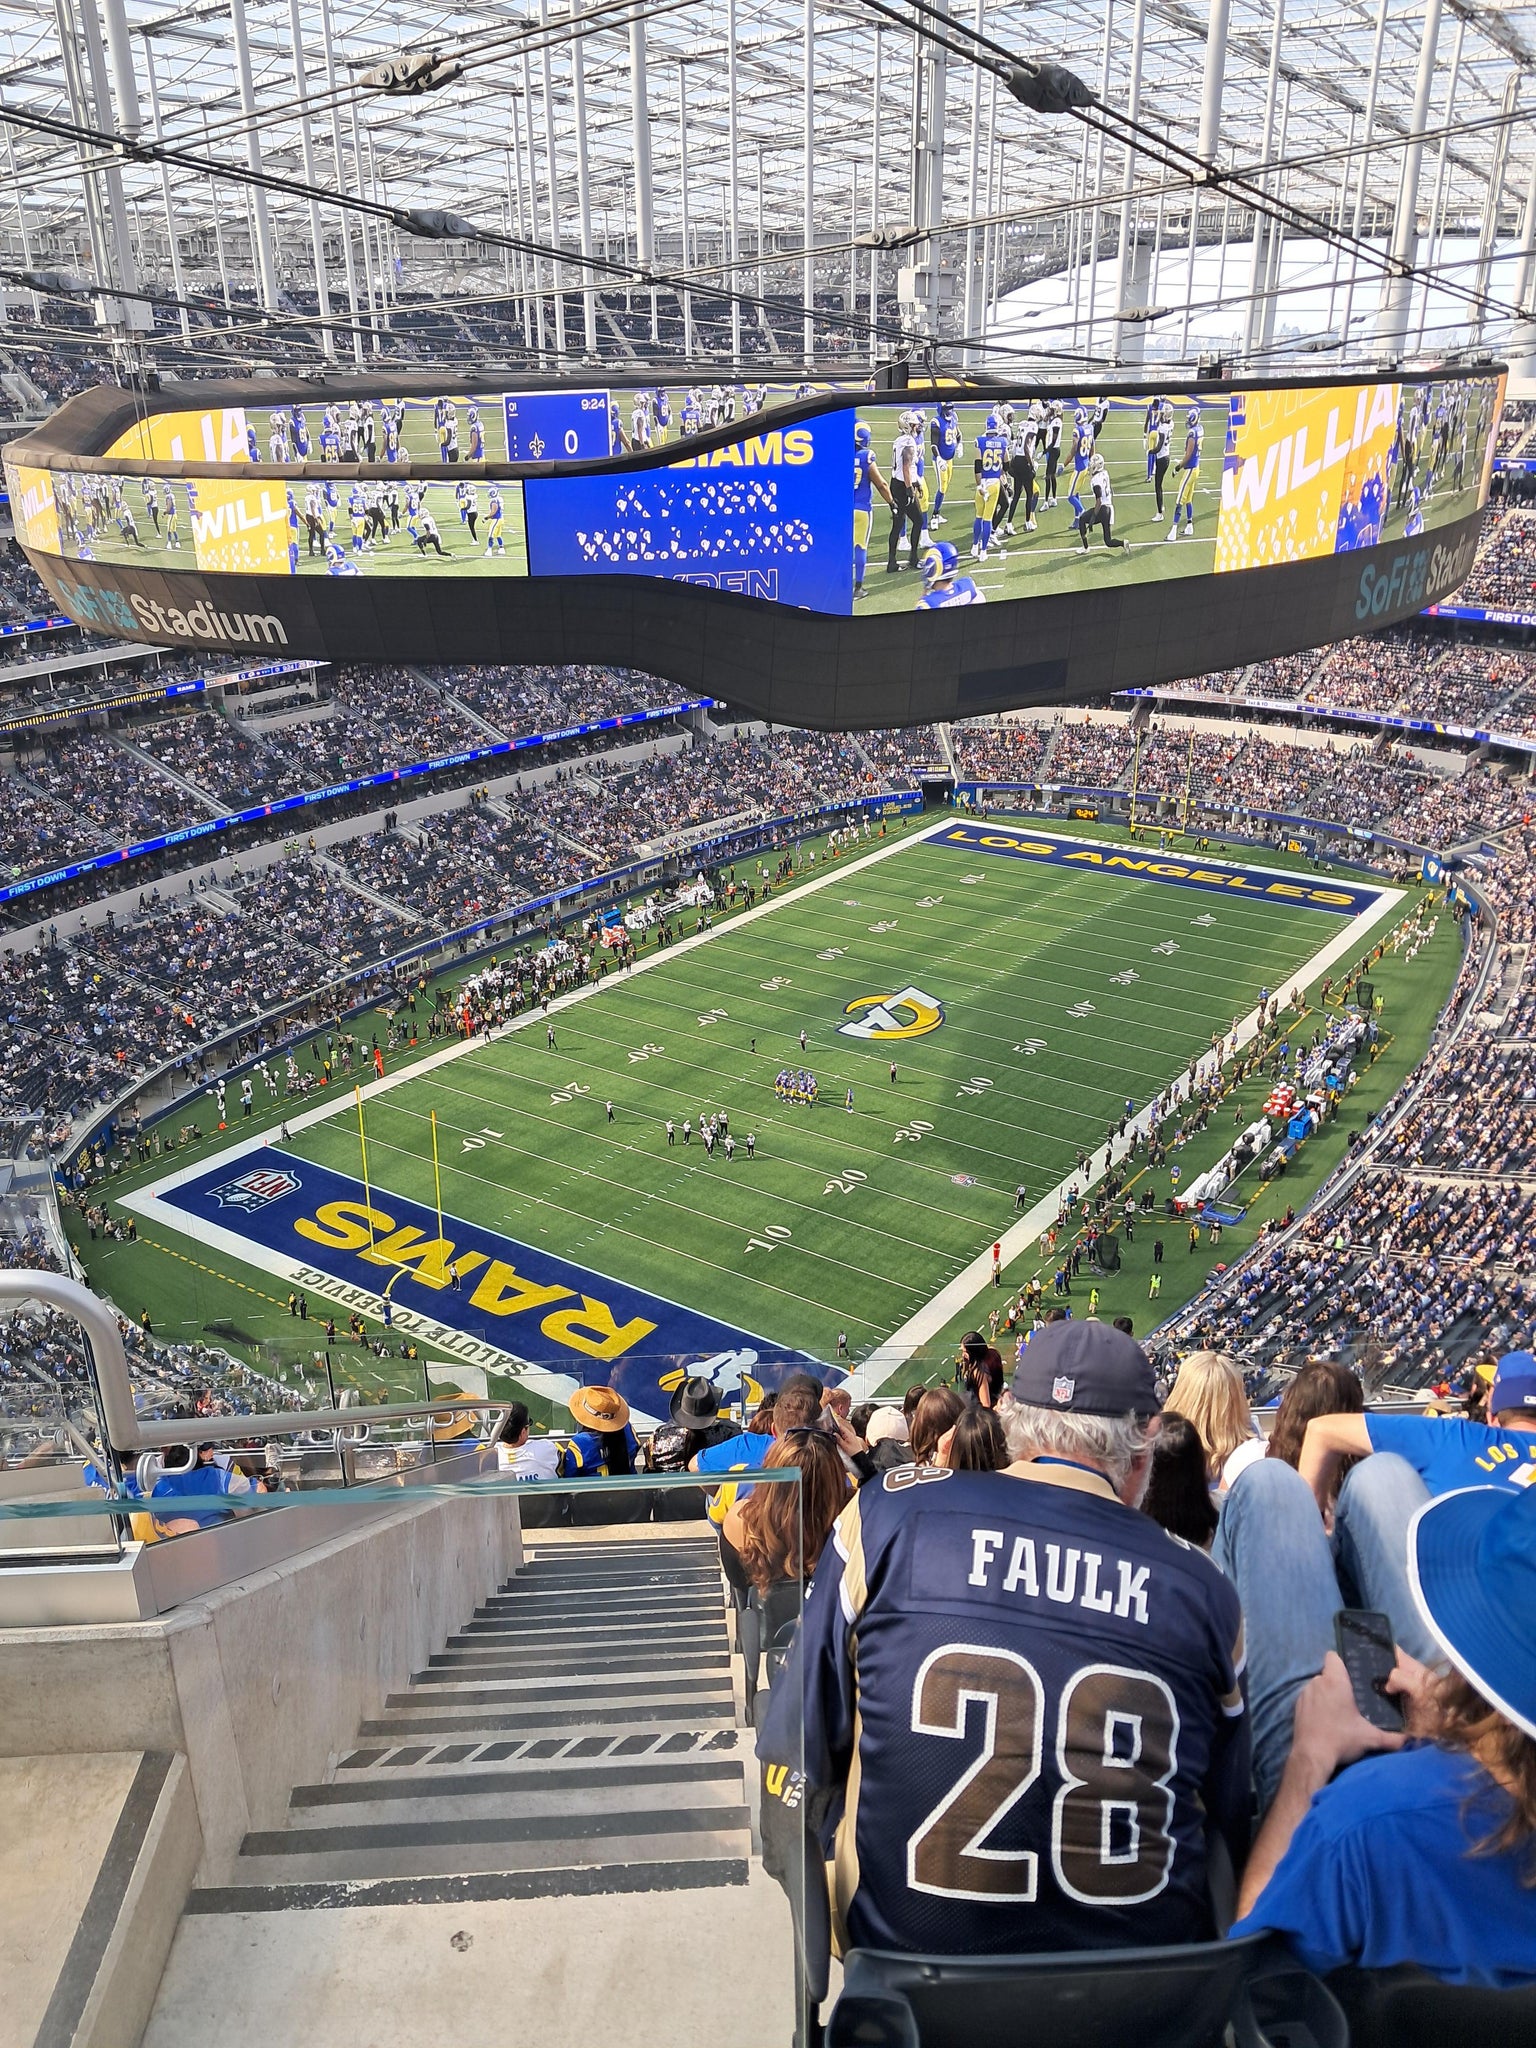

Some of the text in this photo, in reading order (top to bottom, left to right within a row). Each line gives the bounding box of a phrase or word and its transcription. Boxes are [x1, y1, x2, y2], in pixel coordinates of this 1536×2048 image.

[581, 398, 606, 411] 9:24
[564, 429, 579, 455] 0
[982, 449, 1003, 472] 65
[192, 490, 288, 545] WILL
[1355, 555, 1410, 620] SoFi
[129, 593, 288, 645] Stadium
[1484, 611, 1521, 624] FIRST
[428, 758, 449, 770] FIRST
[449, 752, 471, 765] DOWN
[304, 785, 350, 803] FIRST DOWN
[1076, 809, 1094, 819] 9:24
[165, 822, 216, 845] FIRST DOWN
[946, 830, 1356, 906] LOS ANGELES
[9, 871, 67, 897] FIRST DOWN
[1151, 940, 1181, 956] 20
[759, 975, 792, 992] 50
[1109, 969, 1140, 985] 30
[697, 1007, 729, 1026] 40
[1066, 1001, 1096, 1018] 40
[627, 1042, 665, 1062] 30
[1013, 1036, 1048, 1056] 50
[550, 1081, 591, 1103] 20
[959, 1076, 994, 1097] 40
[461, 1126, 505, 1150] 10
[896, 1119, 935, 1142] 30
[242, 1172, 294, 1199] NFL
[826, 1168, 868, 1195] 20
[748, 1224, 792, 1252] 10
[294, 1201, 658, 1362] RAMS
[289, 1267, 529, 1377] SALUTE TO SERVICE
[1475, 1443, 1519, 1472] LOS
[968, 1528, 1151, 1625] FAULK
[906, 1642, 1180, 1906] 28
